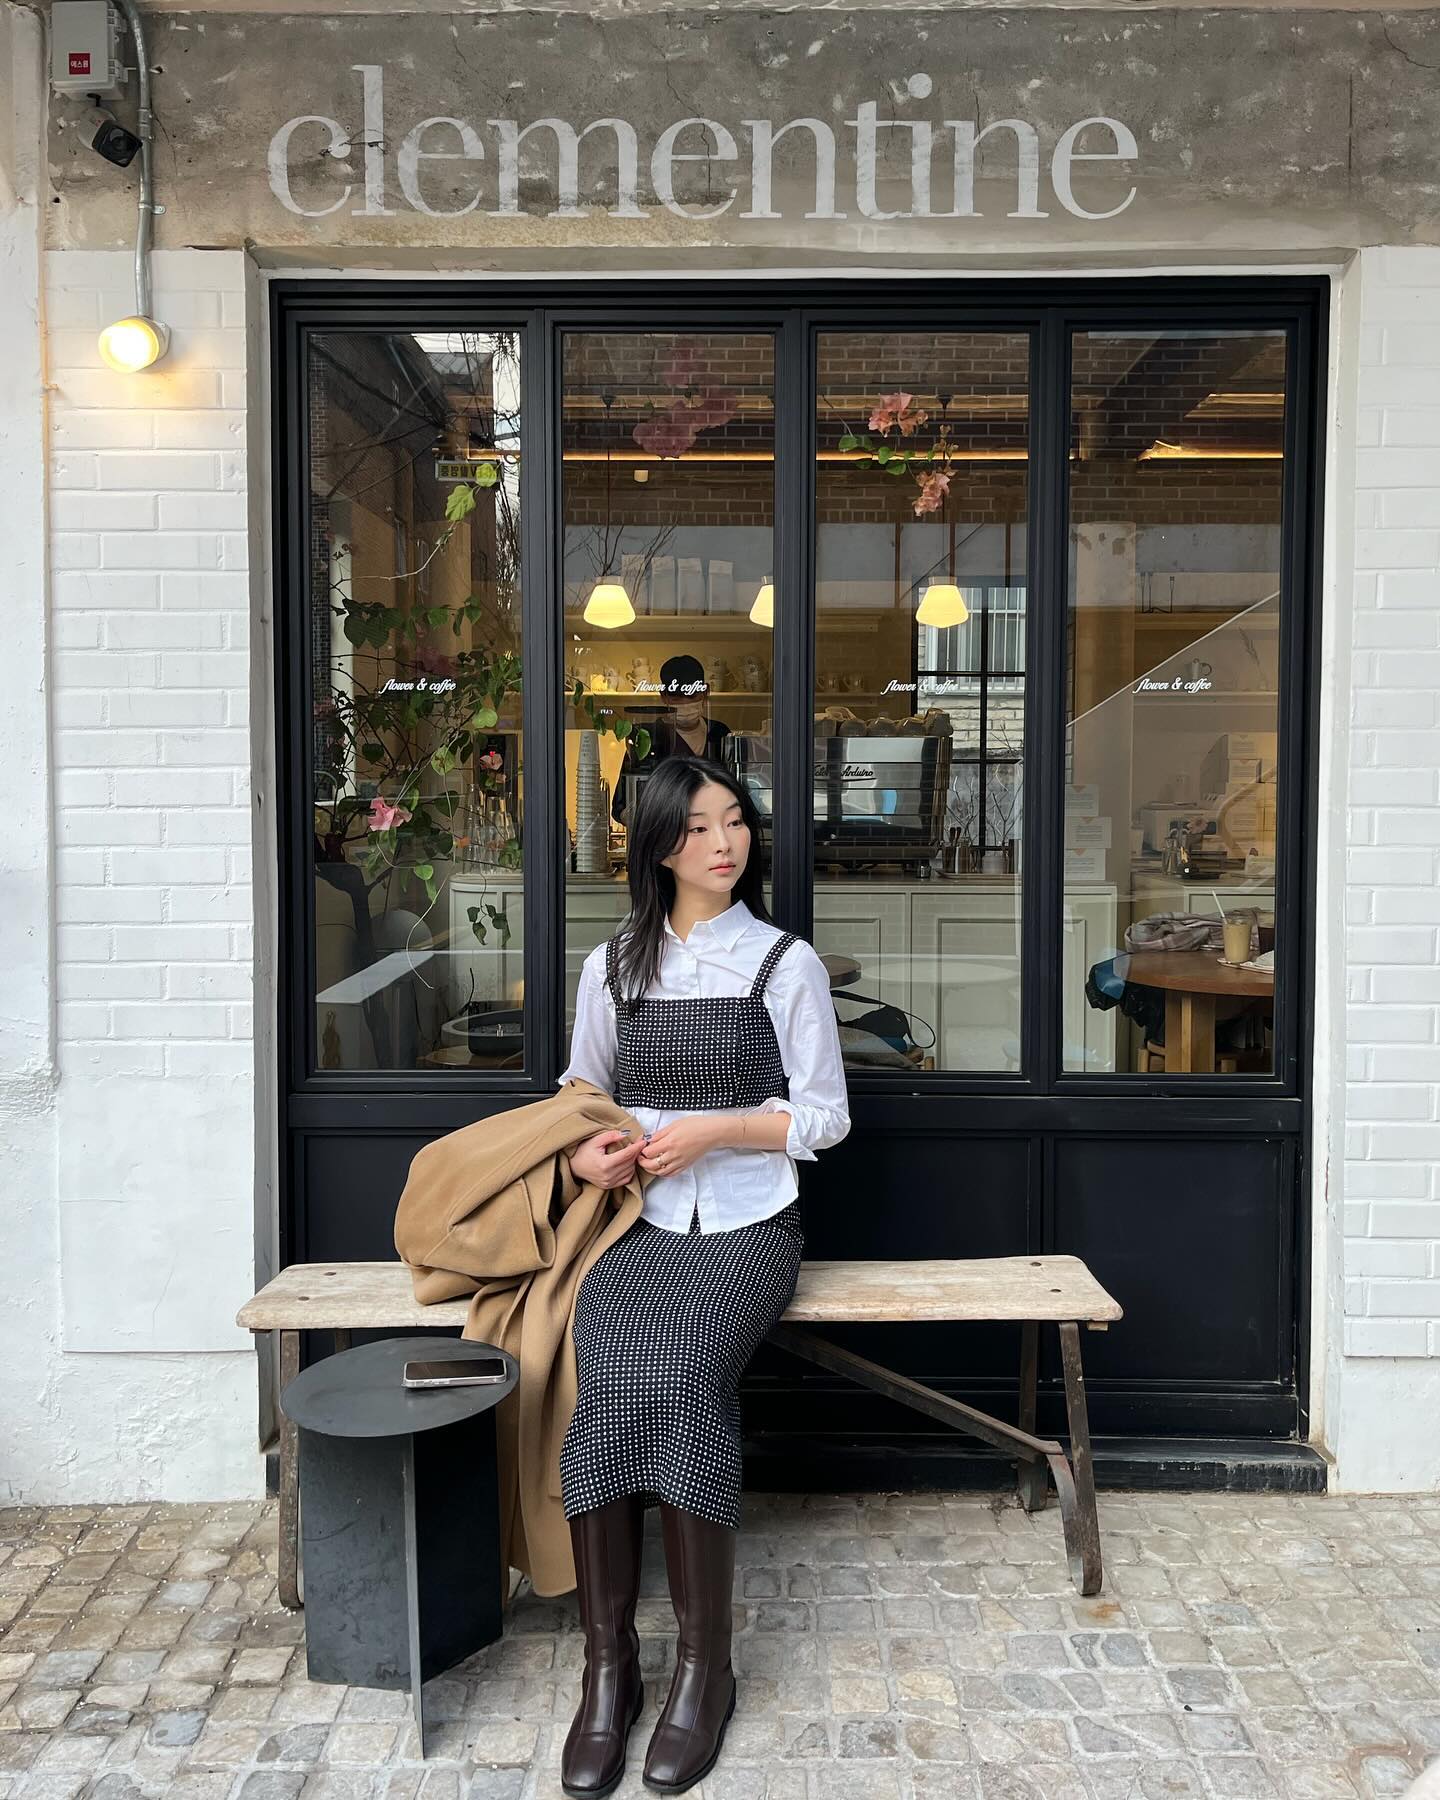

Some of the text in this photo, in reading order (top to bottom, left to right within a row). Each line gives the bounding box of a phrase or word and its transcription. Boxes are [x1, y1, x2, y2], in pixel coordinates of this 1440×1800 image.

[266, 64, 1139, 221] clementine
[378, 677, 457, 695] flower & coffee
[633, 678, 708, 696] flower & coffee
[880, 678, 959, 695] flower & offee
[1132, 676, 1212, 694] flower & coffee
